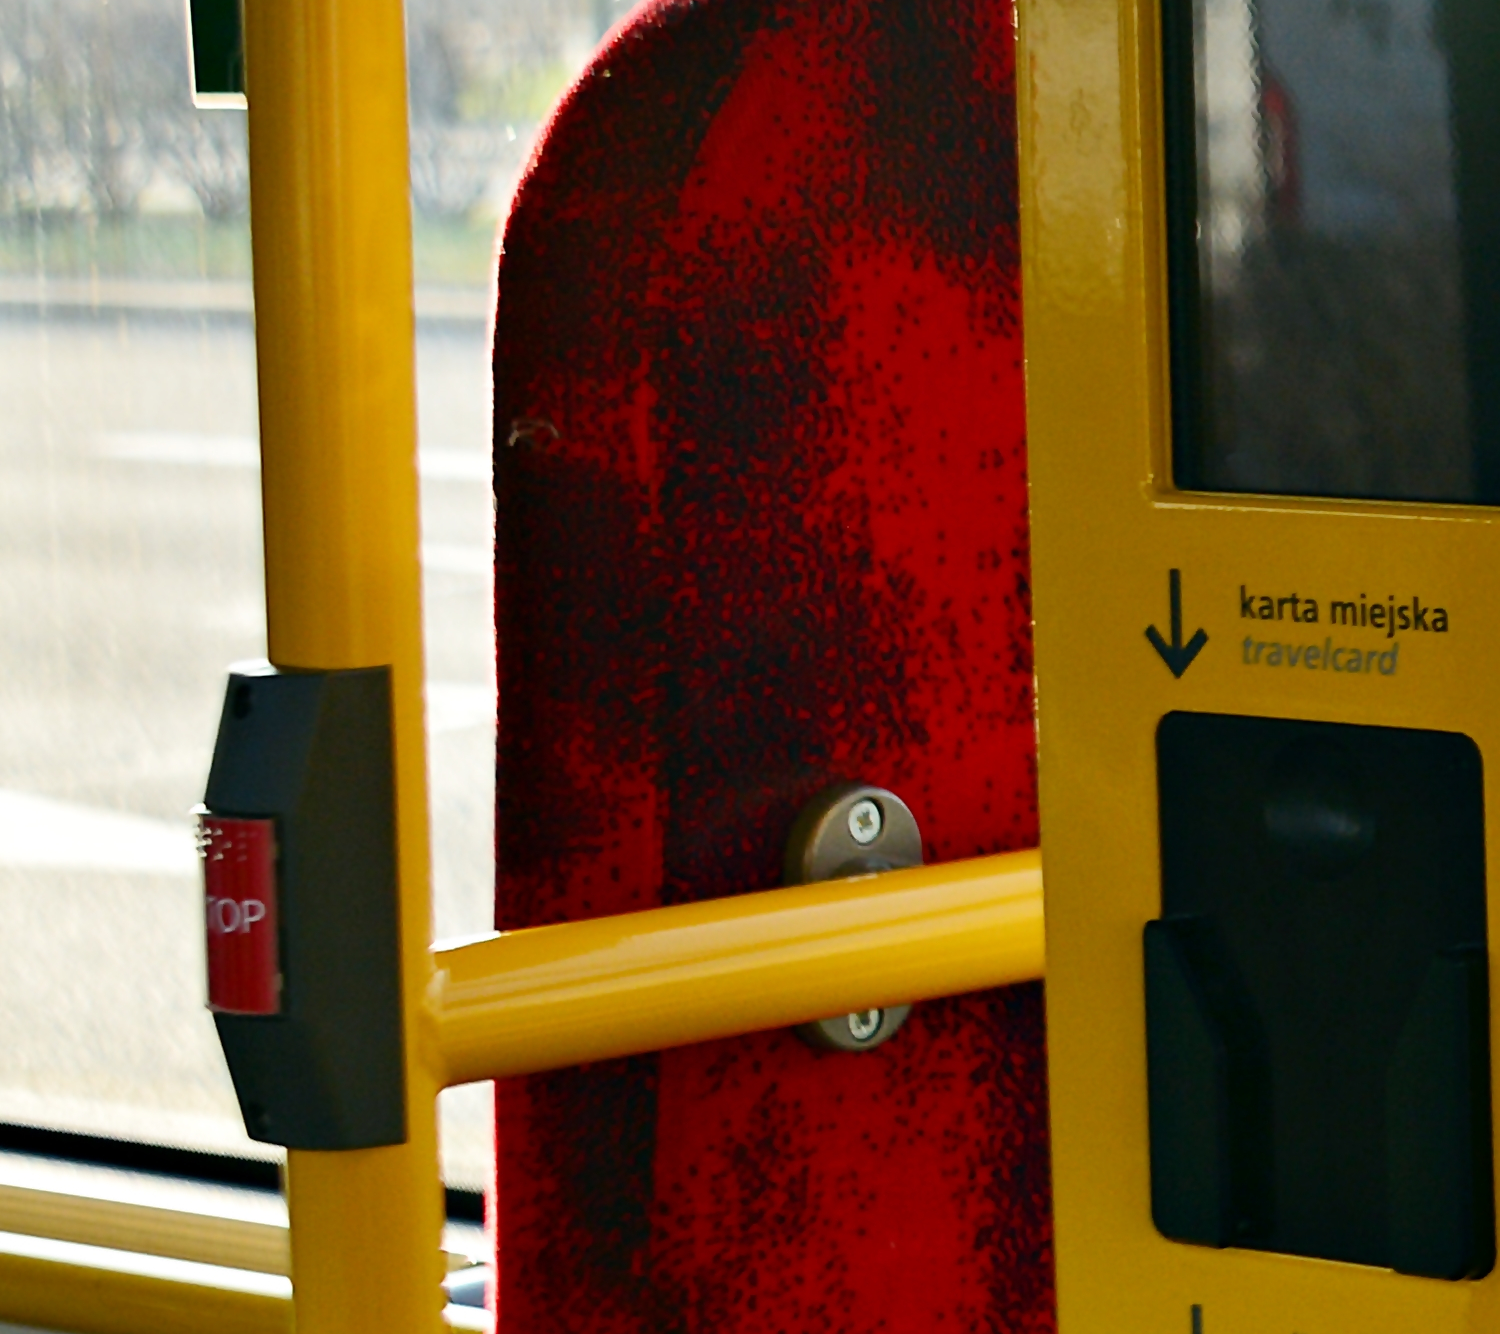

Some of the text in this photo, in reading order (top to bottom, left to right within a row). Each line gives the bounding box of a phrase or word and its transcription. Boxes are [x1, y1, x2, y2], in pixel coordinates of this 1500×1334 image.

[1239, 586, 1448, 637] karta miejska
[1241, 636, 1399, 676] travelcard
